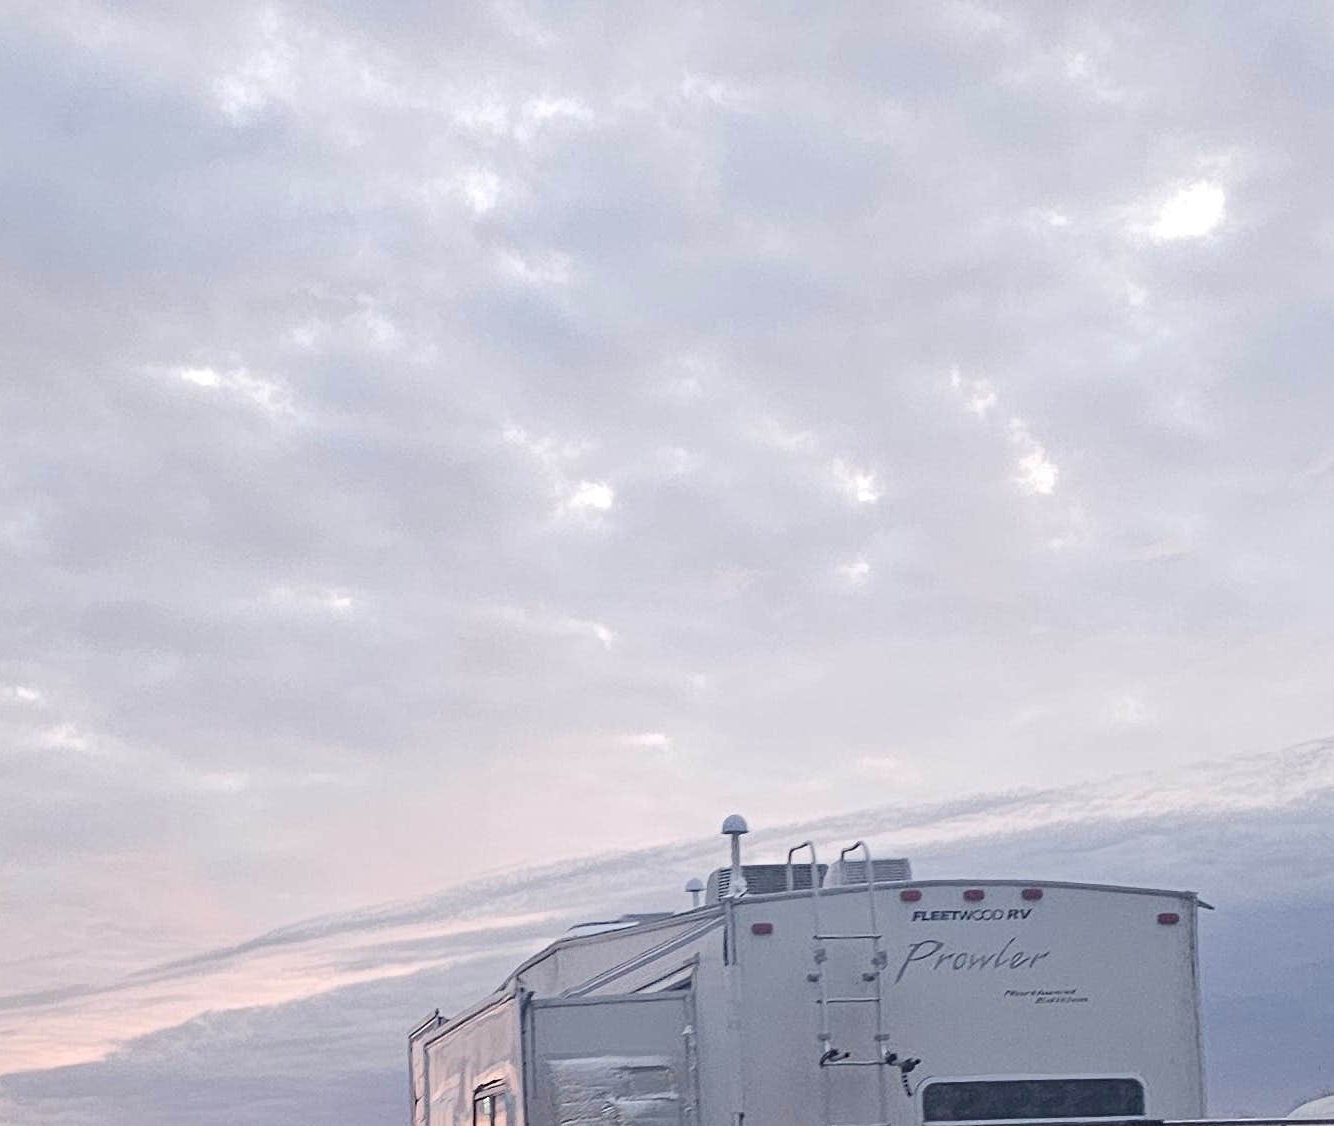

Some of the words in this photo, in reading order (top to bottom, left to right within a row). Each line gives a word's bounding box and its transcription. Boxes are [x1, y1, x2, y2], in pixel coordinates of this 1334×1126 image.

[912, 909, 1004, 921] FLEETWOOD
[1008, 909, 1033, 920] RV
[894, 936, 1051, 984] Prowler
